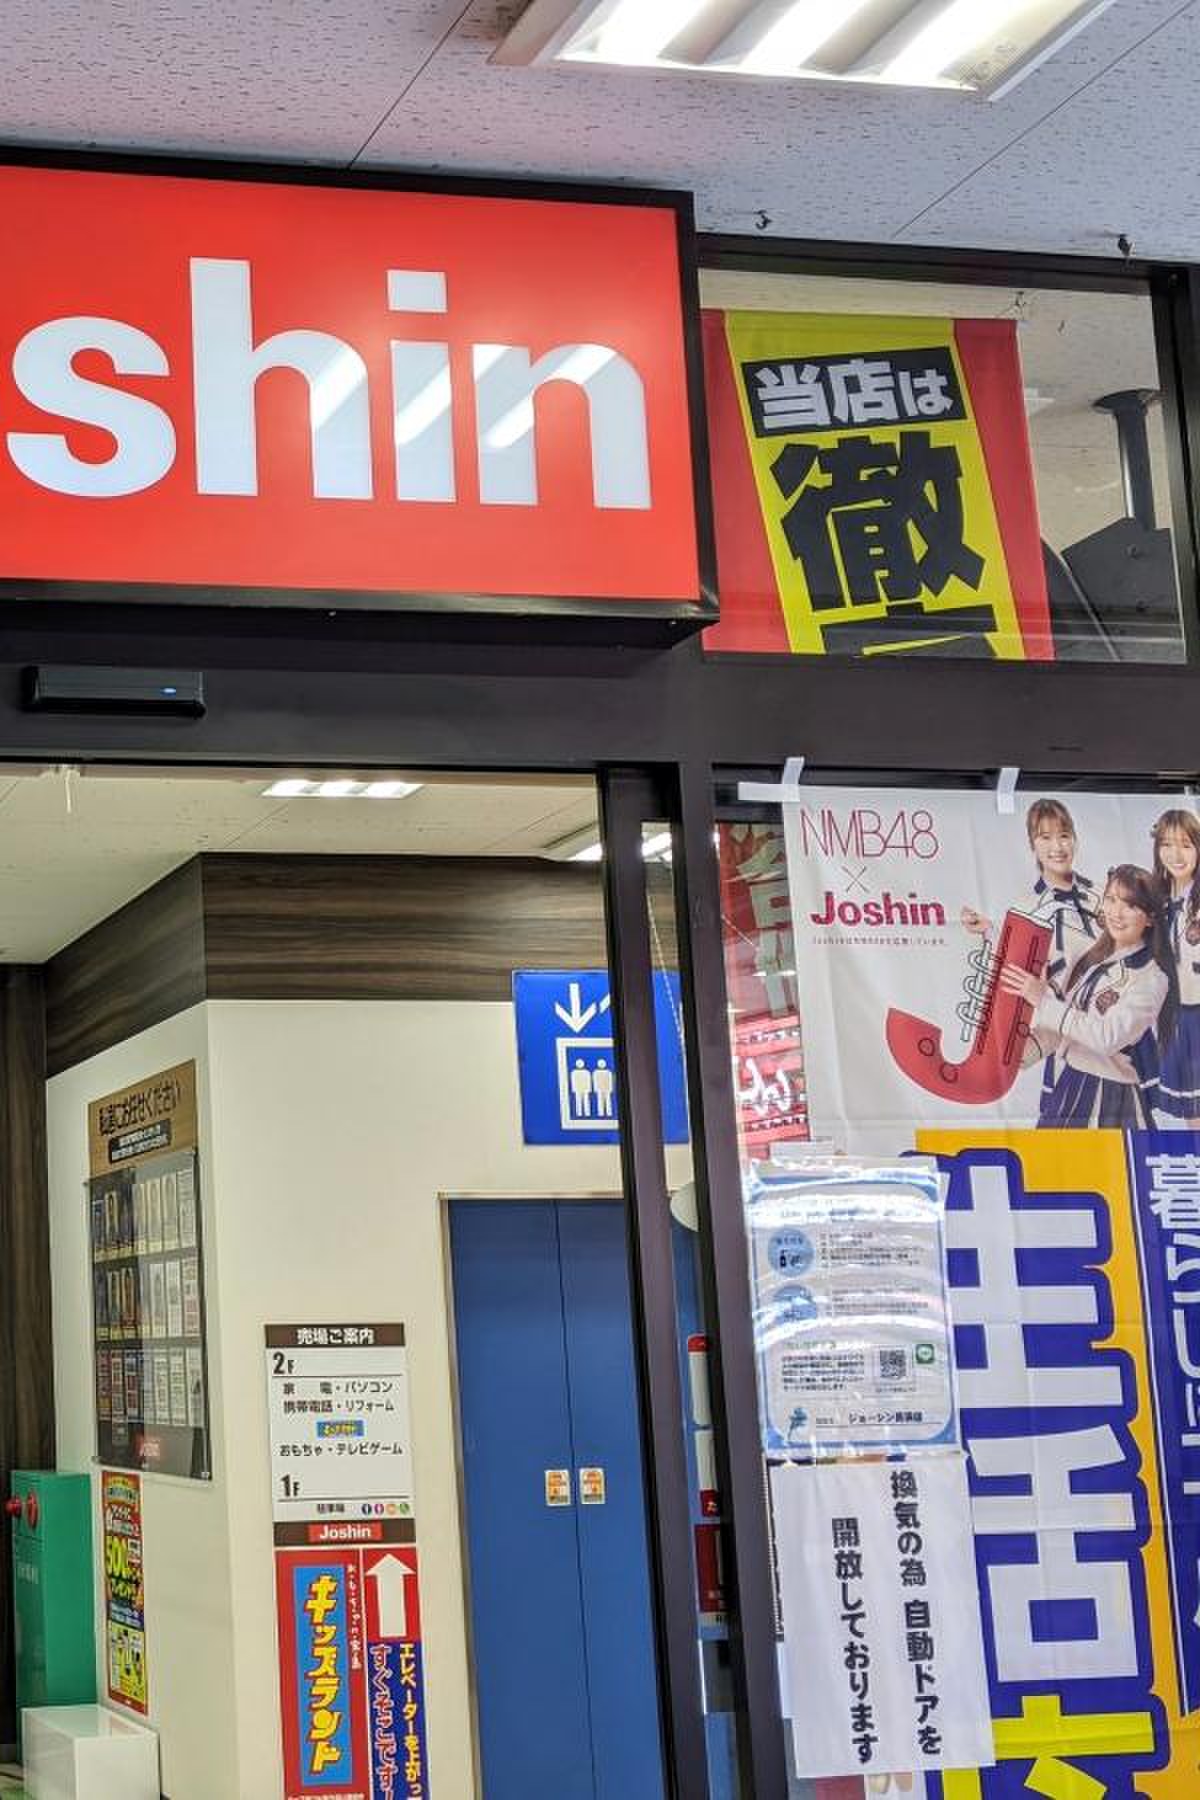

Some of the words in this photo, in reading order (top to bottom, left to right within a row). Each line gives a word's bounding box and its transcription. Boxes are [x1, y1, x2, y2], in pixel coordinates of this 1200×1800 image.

[755, 358, 954, 430] 当店は
[800, 808, 939, 859] NMB48
[811, 891, 946, 927] Joshin
[297, 1328, 375, 1345] 売場ご案内
[273, 1352, 295, 1375] 2F
[280, 1474, 300, 1497] 1F
[319, 1525, 372, 1540] Joshin
[831, 1516, 880, 1764] 開放しております
[304, 1574, 343, 1776] キッズランド
[400, 1643, 422, 1800] エレベーターを上がっ
